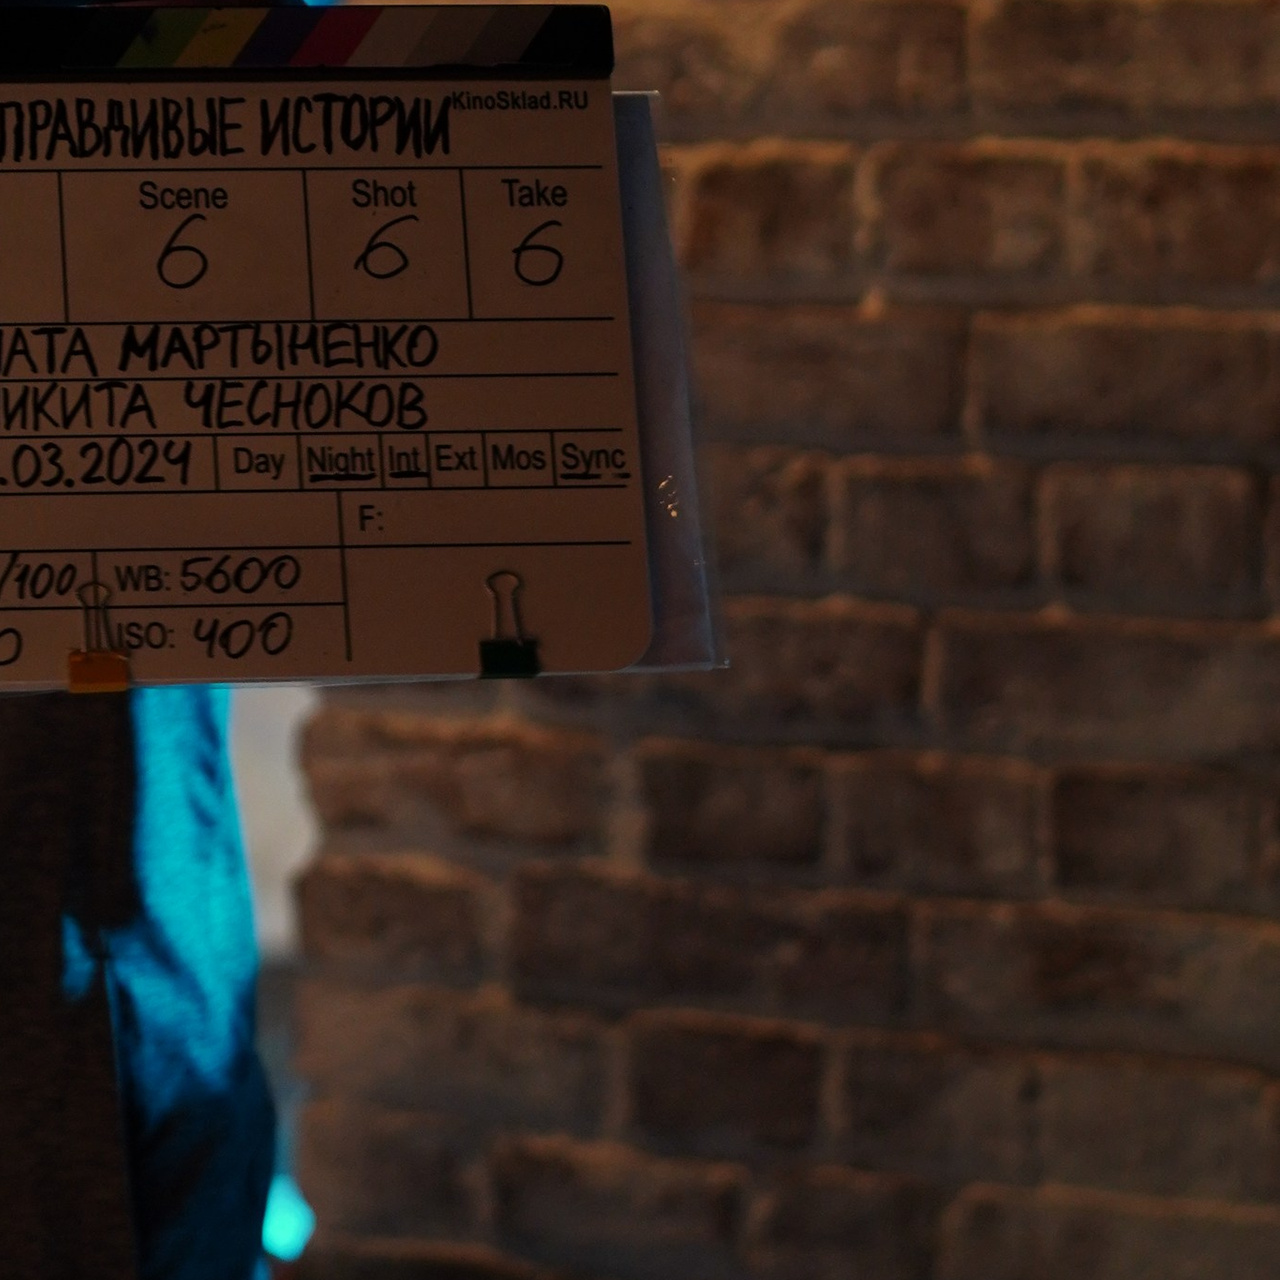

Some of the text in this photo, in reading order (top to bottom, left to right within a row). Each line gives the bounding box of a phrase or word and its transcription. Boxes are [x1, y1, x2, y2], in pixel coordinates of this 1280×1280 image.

[452, 90, 589, 111] KinoSklad.RU
[261, 93, 450, 158] ИСТОРИИ
[139, 181, 228, 211] Scene
[352, 179, 418, 208] Shot
[502, 179, 568, 208] Take
[157, 214, 208, 289] 6
[353, 214, 419, 279] 6
[512, 220, 563, 286] 6
[118, 322, 438, 372] МАРТЫНЕНКО
[185, 380, 428, 431] ЧЕСНОКОВ
[234, 447, 285, 480] Day
[307, 445, 376, 476] Night
[390, 445, 420, 471] Int
[437, 444, 478, 471] Ext
[492, 443, 546, 470] Mos
[562, 442, 626, 476] Sync
[359, 504, 385, 531] F:
[116, 565, 171, 592] WB:
[181, 555, 300, 593] 5600
[117, 621, 176, 650] ISO:
[193, 612, 293, 659] 400
